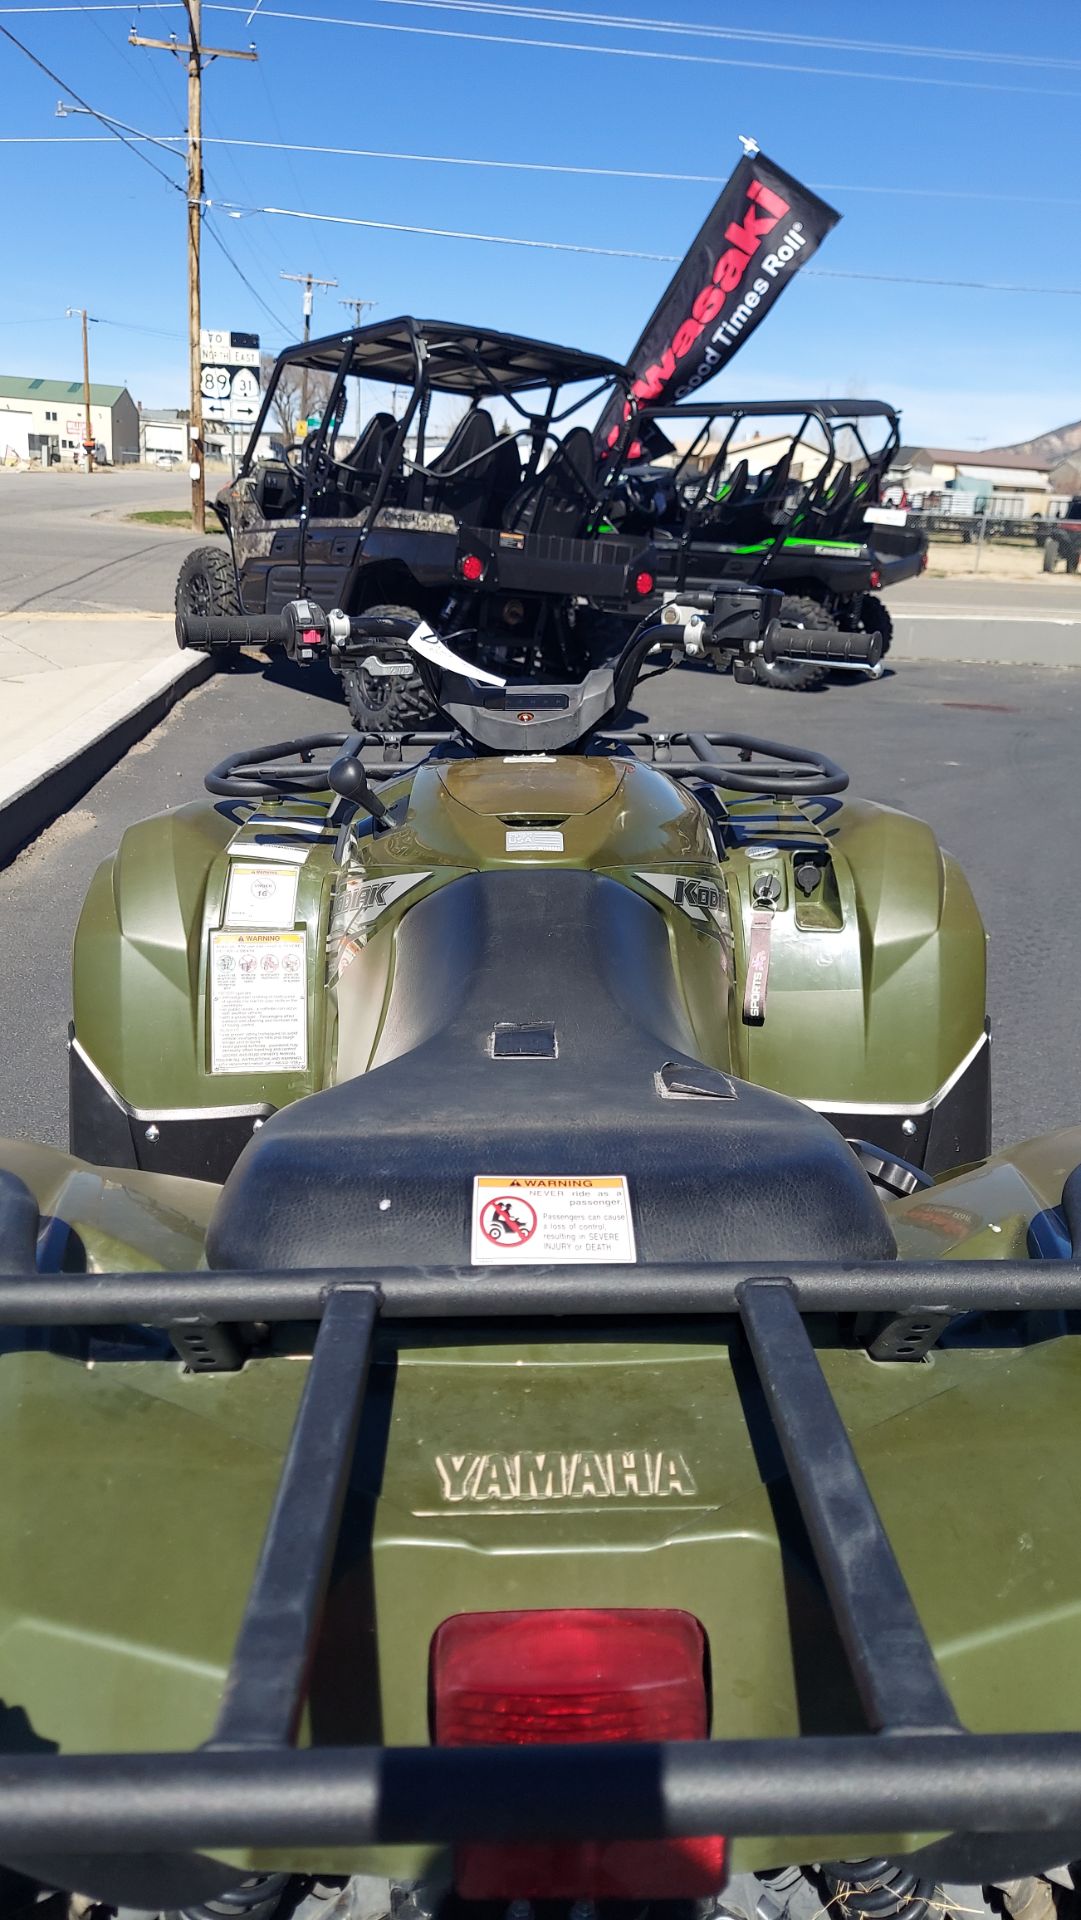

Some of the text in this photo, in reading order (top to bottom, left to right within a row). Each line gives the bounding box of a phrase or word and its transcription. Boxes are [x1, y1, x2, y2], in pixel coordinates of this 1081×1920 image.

[208, 333, 222, 343] TO
[674, 346, 722, 399] Good
[711, 277, 770, 347] Times
[202, 349, 229, 360] NORTH
[235, 351, 254, 362] EAST
[205, 374, 226, 390] 89
[239, 379, 252, 391] 31
[750, 972, 763, 1017] SPORTS
[525, 1179, 594, 1188] WARNING
[543, 1213, 585, 1221] Passengers
[543, 1233, 576, 1241] resulting
[588, 1232, 620, 1241] SEVERE
[543, 1243, 571, 1251] INJURY
[434, 1450, 697, 1501] YAMAHA
